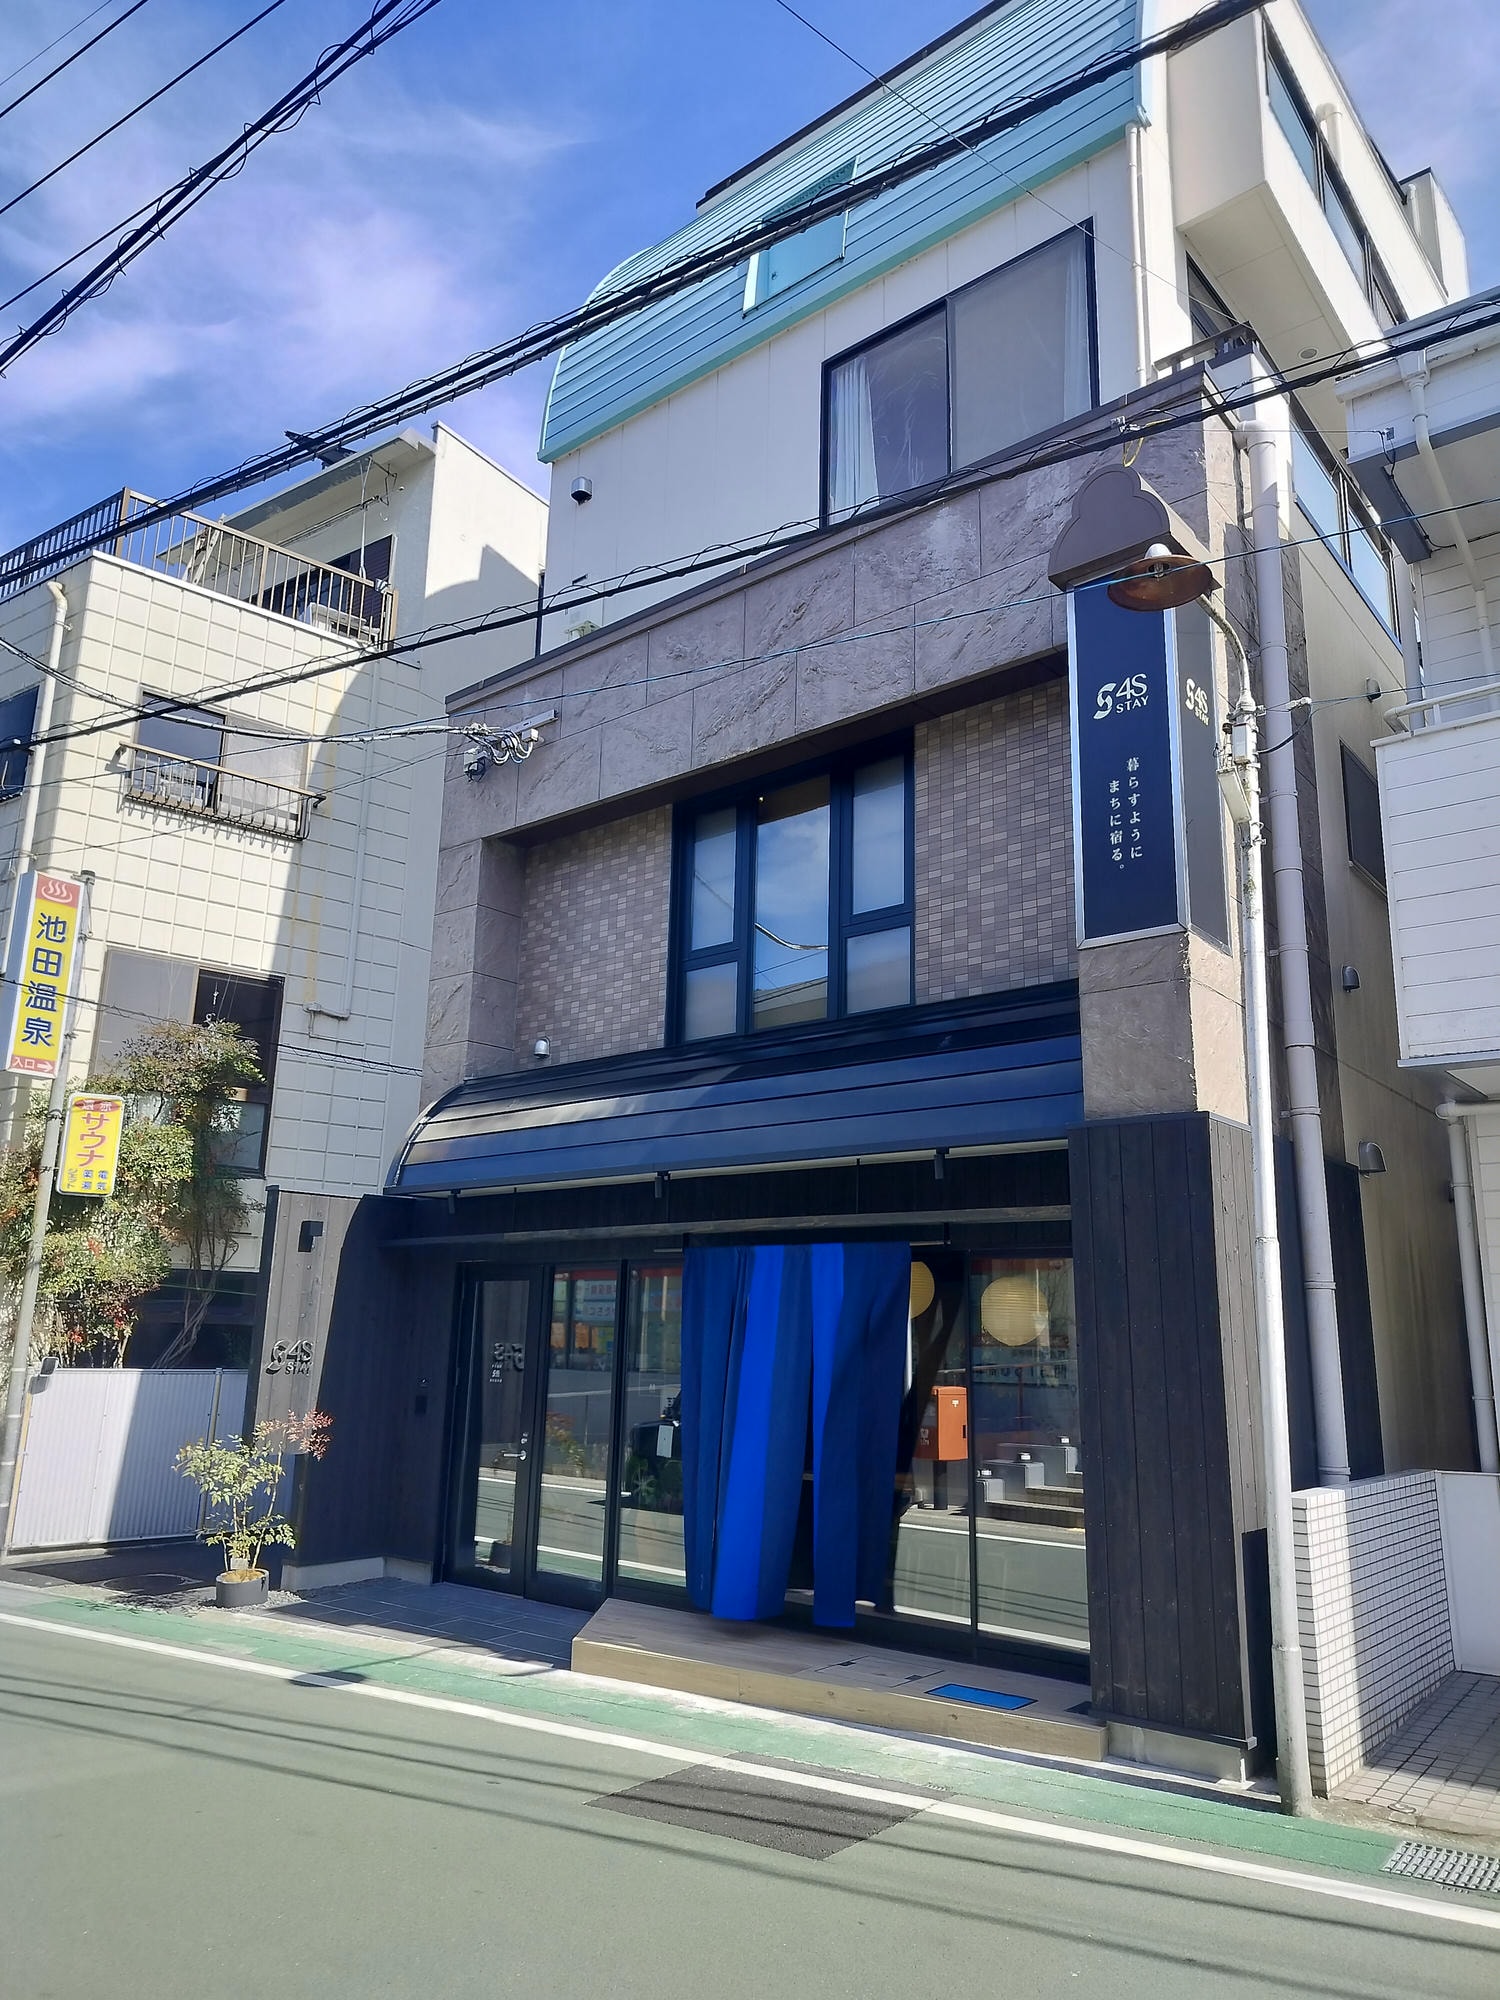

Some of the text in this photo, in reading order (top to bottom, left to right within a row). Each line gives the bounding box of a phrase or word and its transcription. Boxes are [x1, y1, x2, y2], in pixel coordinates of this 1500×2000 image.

[1115, 673, 1148, 700] 4S
[1115, 695, 1149, 714] STAY
[1108, 779, 1125, 870] まちに宿る。
[1126, 757, 1143, 859] 暮らすように
[21, 912, 67, 1047] 池田温泉
[12, 1056, 36, 1070] 入口
[76, 1112, 111, 1167] サウナ
